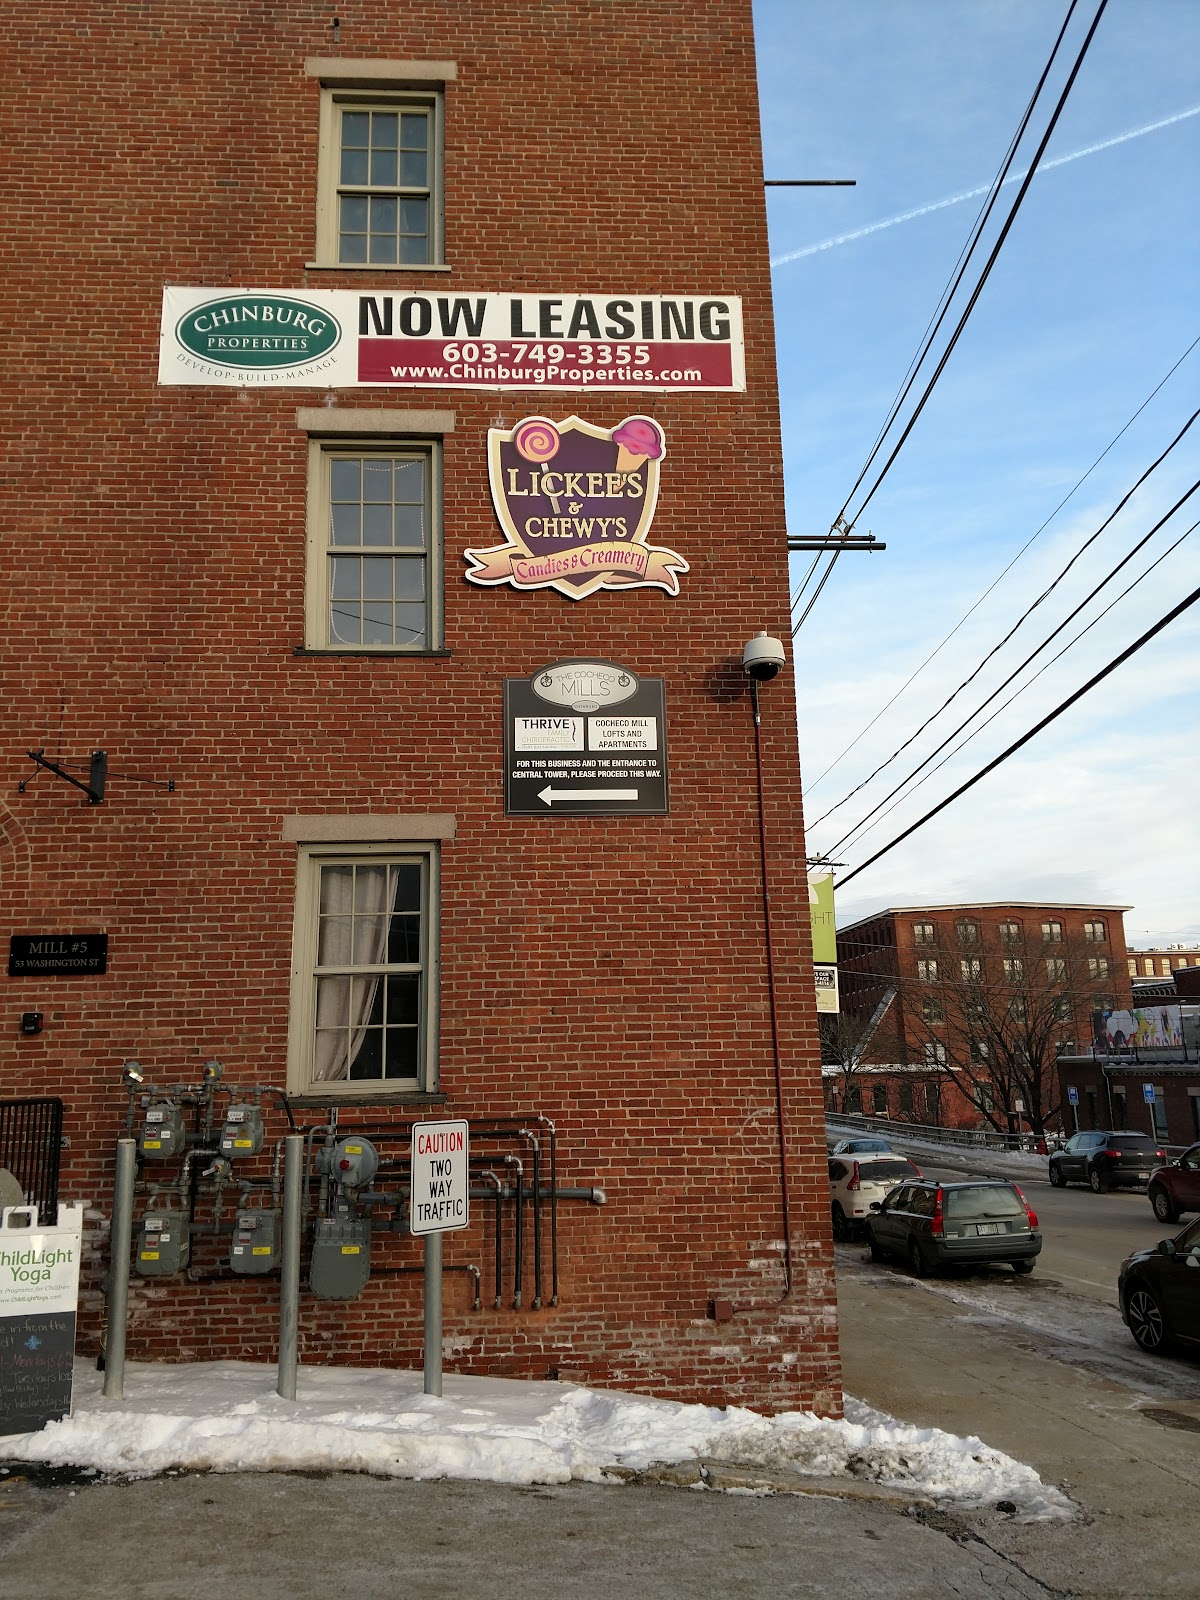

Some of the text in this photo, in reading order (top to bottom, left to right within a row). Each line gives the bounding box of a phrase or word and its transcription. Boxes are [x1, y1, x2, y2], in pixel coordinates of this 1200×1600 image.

[193, 305, 327, 336] CHINBURG
[358, 296, 731, 341] NOW LEASING
[207, 337, 308, 349] PROPERTIES
[442, 342, 651, 364] 603-749-3355
[390, 363, 702, 383] www.ChinburgProperties.com
[506, 468, 644, 498] LICKEE'S
[568, 501, 584, 515] &
[525, 516, 628, 539] CHEWY'S
[555, 670, 616, 683] THE COCHECO
[561, 680, 611, 697] MILLS
[521, 718, 570, 729] THRIVE
[595, 719, 649, 727] COCHECO MILL
[602, 730, 642, 738] LOFTS AND
[598, 740, 648, 748] APARTMENTS
[516, 759, 657, 768] FOR THIS BUSINESS AND THE ENTRANCE TO
[512, 770, 662, 779] CENTRAL TOWER, PLEASE PROCEED THIS WAY.
[28, 941, 88, 954] MILL #5
[15, 958, 100, 968] 53 WASHINGTON ST
[417, 1131, 463, 1155] CAUTION
[429, 1158, 452, 1178] TWO
[429, 1179, 453, 1199] WAY
[417, 1198, 463, 1222] TRAFFIC
[0, 1248, 73, 1268] hildLight
[10, 1266, 51, 1285] Yoga
